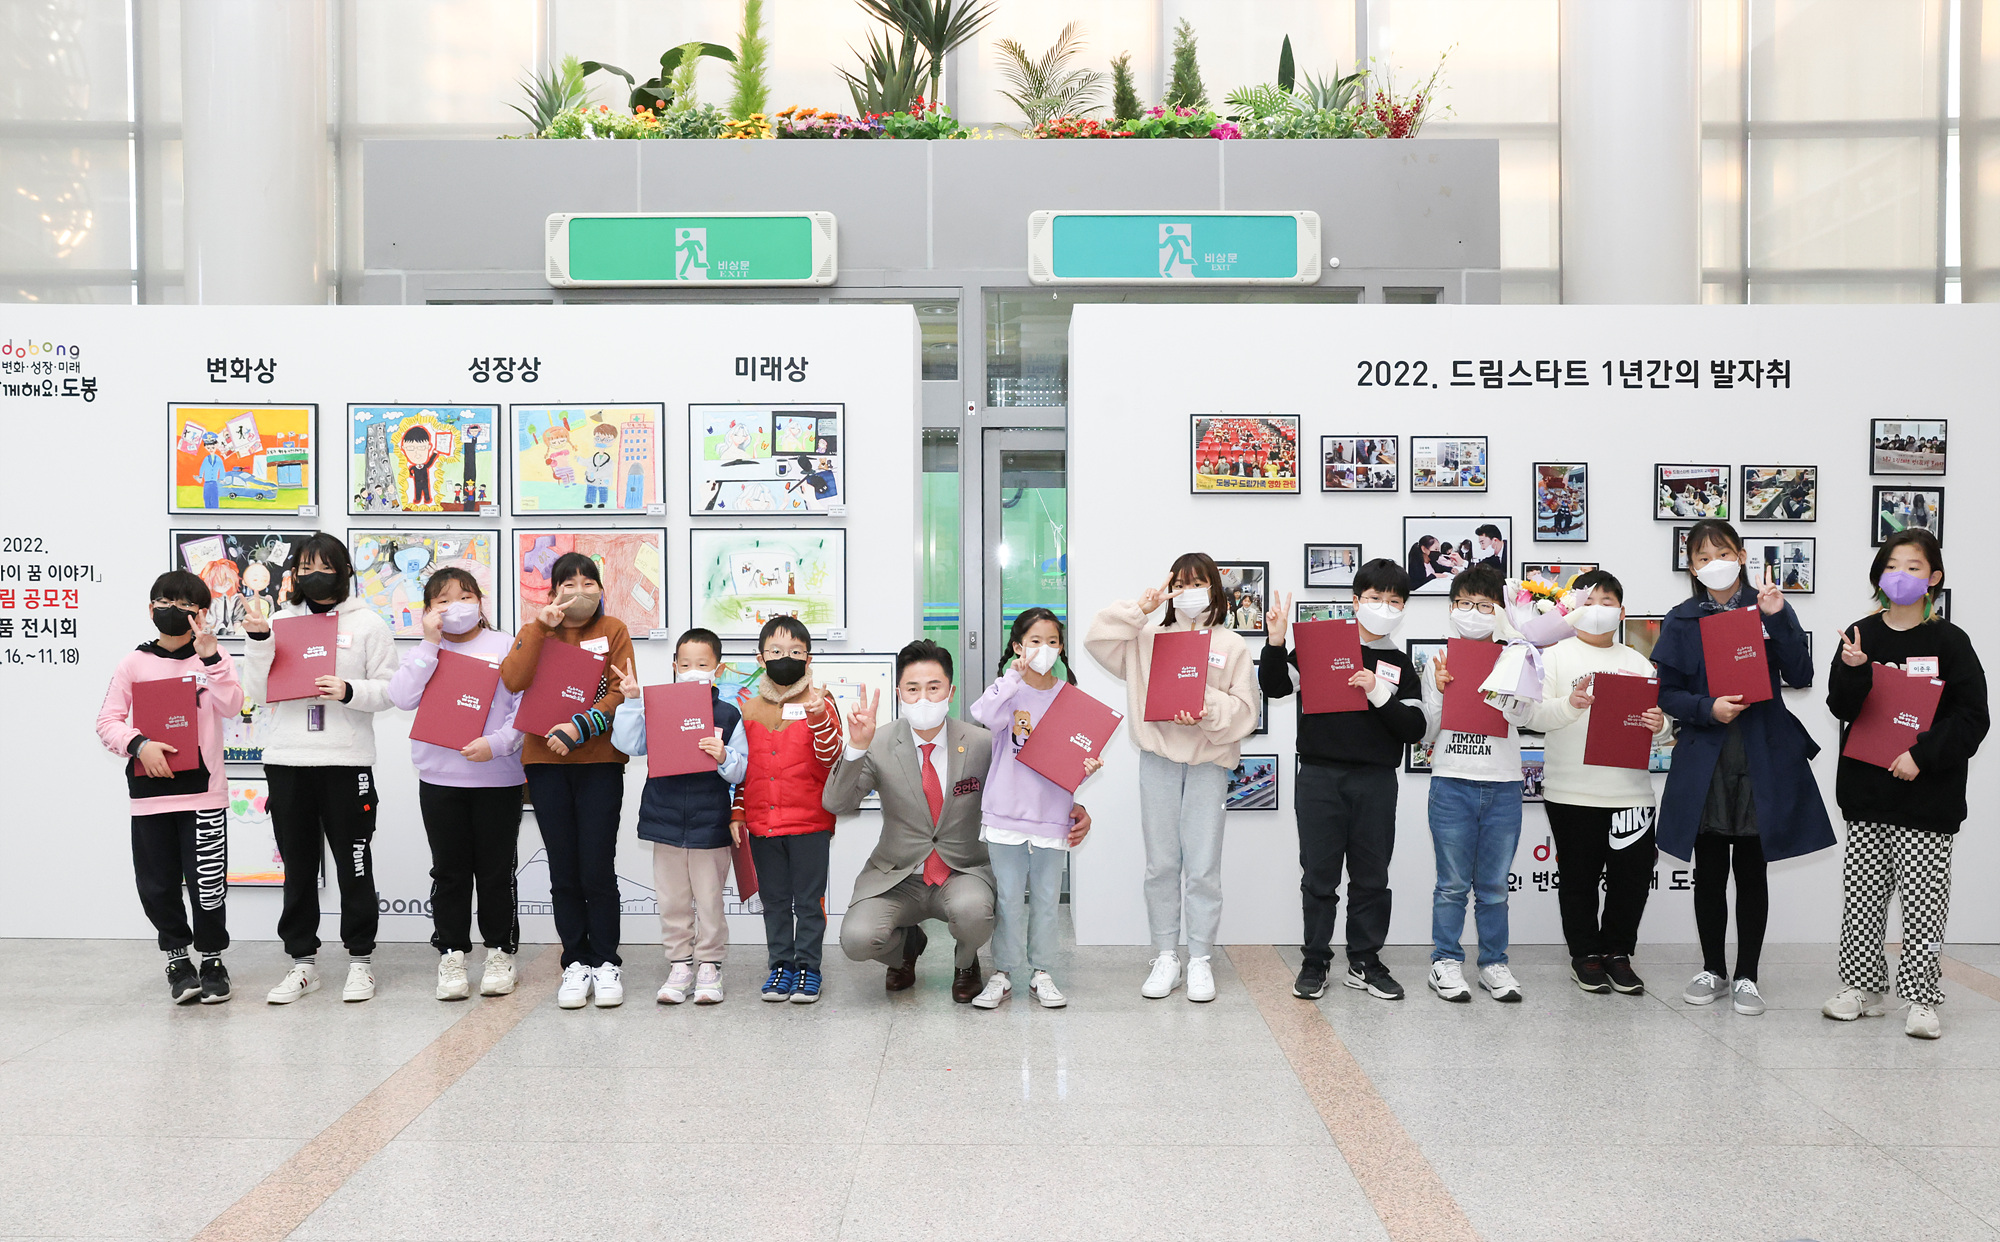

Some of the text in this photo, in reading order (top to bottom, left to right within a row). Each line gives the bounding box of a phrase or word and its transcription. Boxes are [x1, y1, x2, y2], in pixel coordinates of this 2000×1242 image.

[718, 260, 750, 271] 비상문
[1204, 252, 1238, 263] 비상문
[1211, 263, 1231, 271] EXIT
[719, 270, 749, 278] EXIT
[2, 339, 80, 360] dobong
[206, 357, 277, 384] 변화상
[468, 356, 542, 384] 성장상
[735, 356, 809, 383] 미래상
[1357, 358, 1792, 389] 2022. 드림스타트 1년간의 발자취
[0, 376, 98, 402] 께해요! 도봉
[1216, 478, 1238, 487] 도봉구
[1268, 480, 1281, 488] 영화
[3, 537, 48, 554] 2022.
[27, 564, 42, 582] 꿈
[23, 588, 79, 610] 공모전
[21, 617, 77, 639] 전시회
[953, 782, 980, 797] 오언석
[1612, 806, 1651, 834] NIKE
